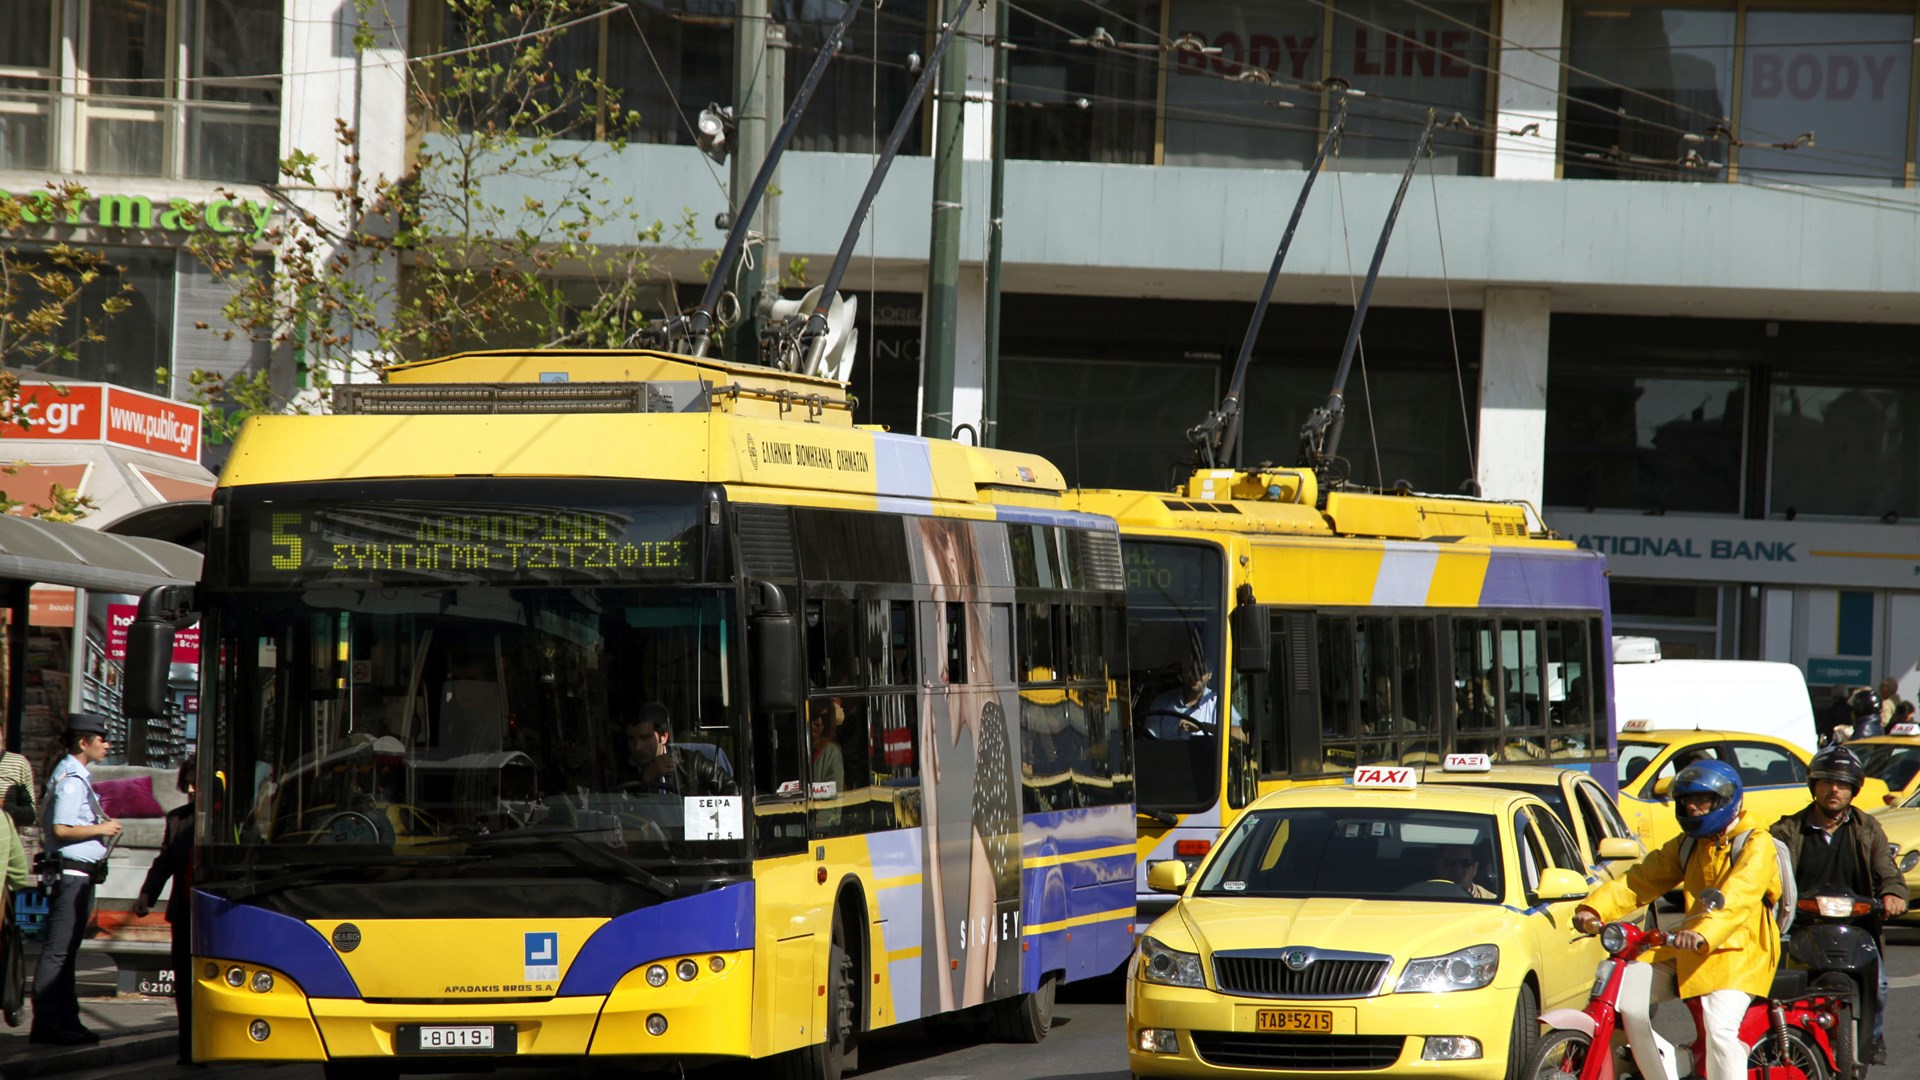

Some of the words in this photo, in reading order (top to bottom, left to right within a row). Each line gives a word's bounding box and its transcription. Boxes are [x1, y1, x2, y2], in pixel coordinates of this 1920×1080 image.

[1176, 30, 1316, 80] BODY
[1353, 28, 1471, 78] LINE
[1751, 52, 1898, 101] BODY
[0, 190, 275, 239] armacy
[110, 405, 194, 453] www.public.gr
[761, 441, 792, 465] ΕΛΛΗΝΙΚΗ
[272, 513, 302, 569] 5
[1567, 534, 1702, 559] ATIONAL
[1710, 539, 1798, 562] BANK
[1357, 769, 1409, 783] TAXI
[709, 811, 720, 829] 1
[960, 910, 1020, 950] SISLEY
[502, 984, 533, 993] BROS
[431, 1030, 482, 1046] 8019
